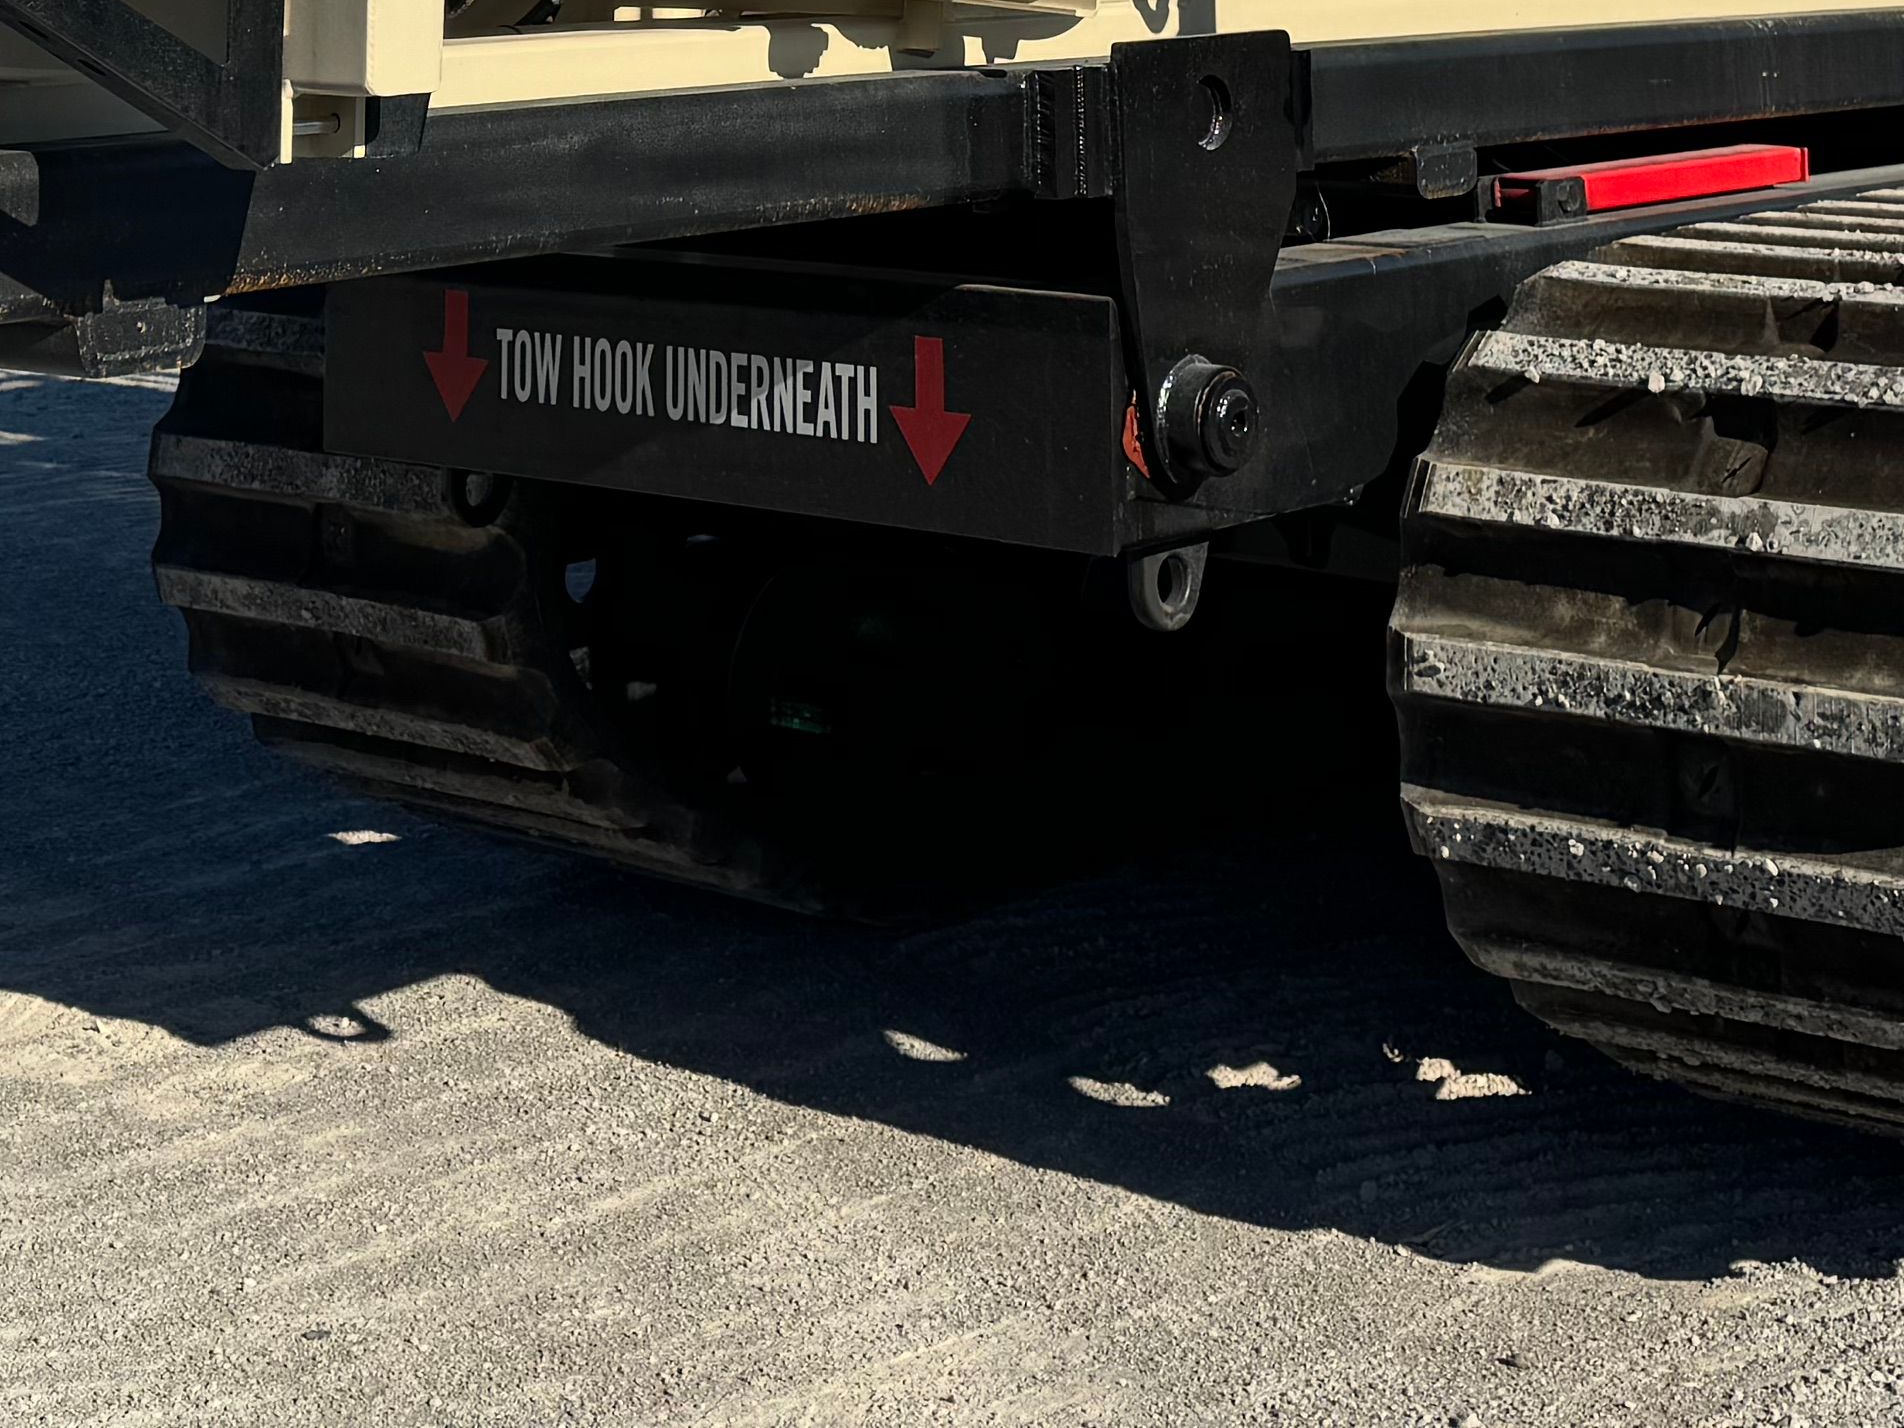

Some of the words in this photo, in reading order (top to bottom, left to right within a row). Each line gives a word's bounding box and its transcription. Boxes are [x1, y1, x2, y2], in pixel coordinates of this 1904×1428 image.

[496, 327, 563, 406] TOW
[572, 335, 656, 418] HOOK
[665, 347, 879, 444] UNDERNEATH
